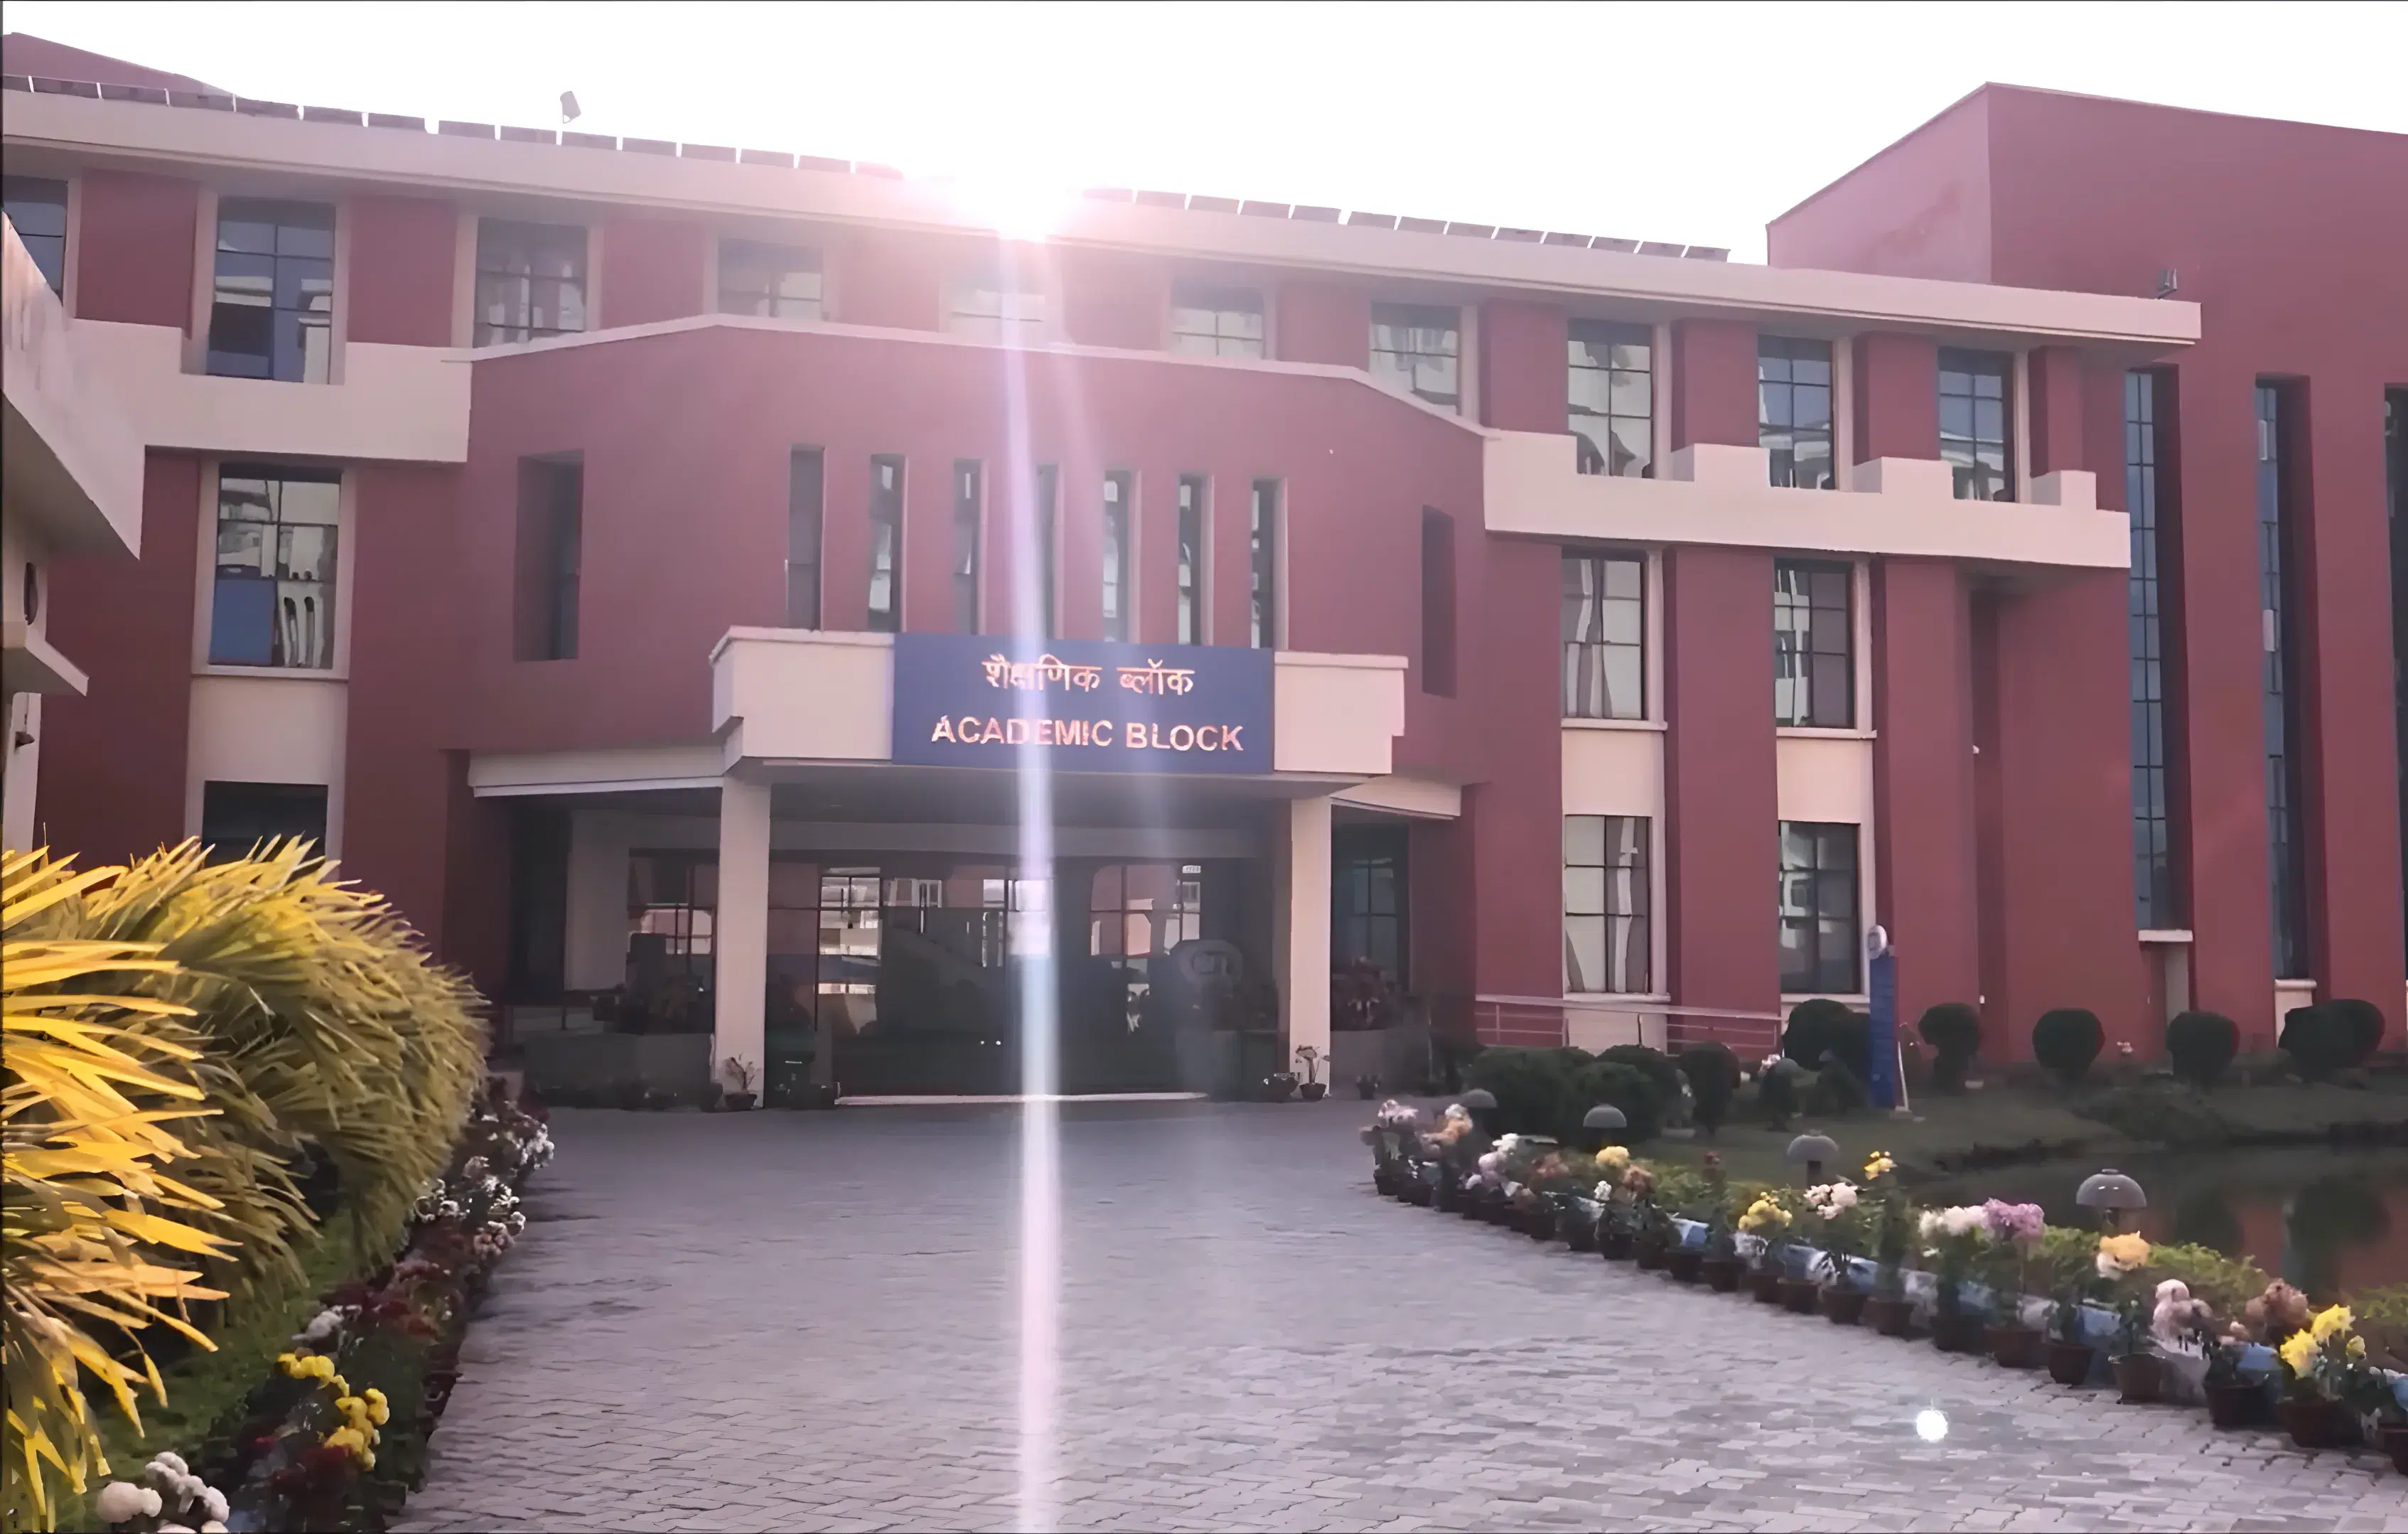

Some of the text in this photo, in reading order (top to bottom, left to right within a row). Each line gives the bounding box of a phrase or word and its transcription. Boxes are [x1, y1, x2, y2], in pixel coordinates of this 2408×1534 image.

[982, 653, 1195, 695] शैक्षणिक ब्लॉक
[931, 715, 1244, 751] ACADEMIC BLOCK
